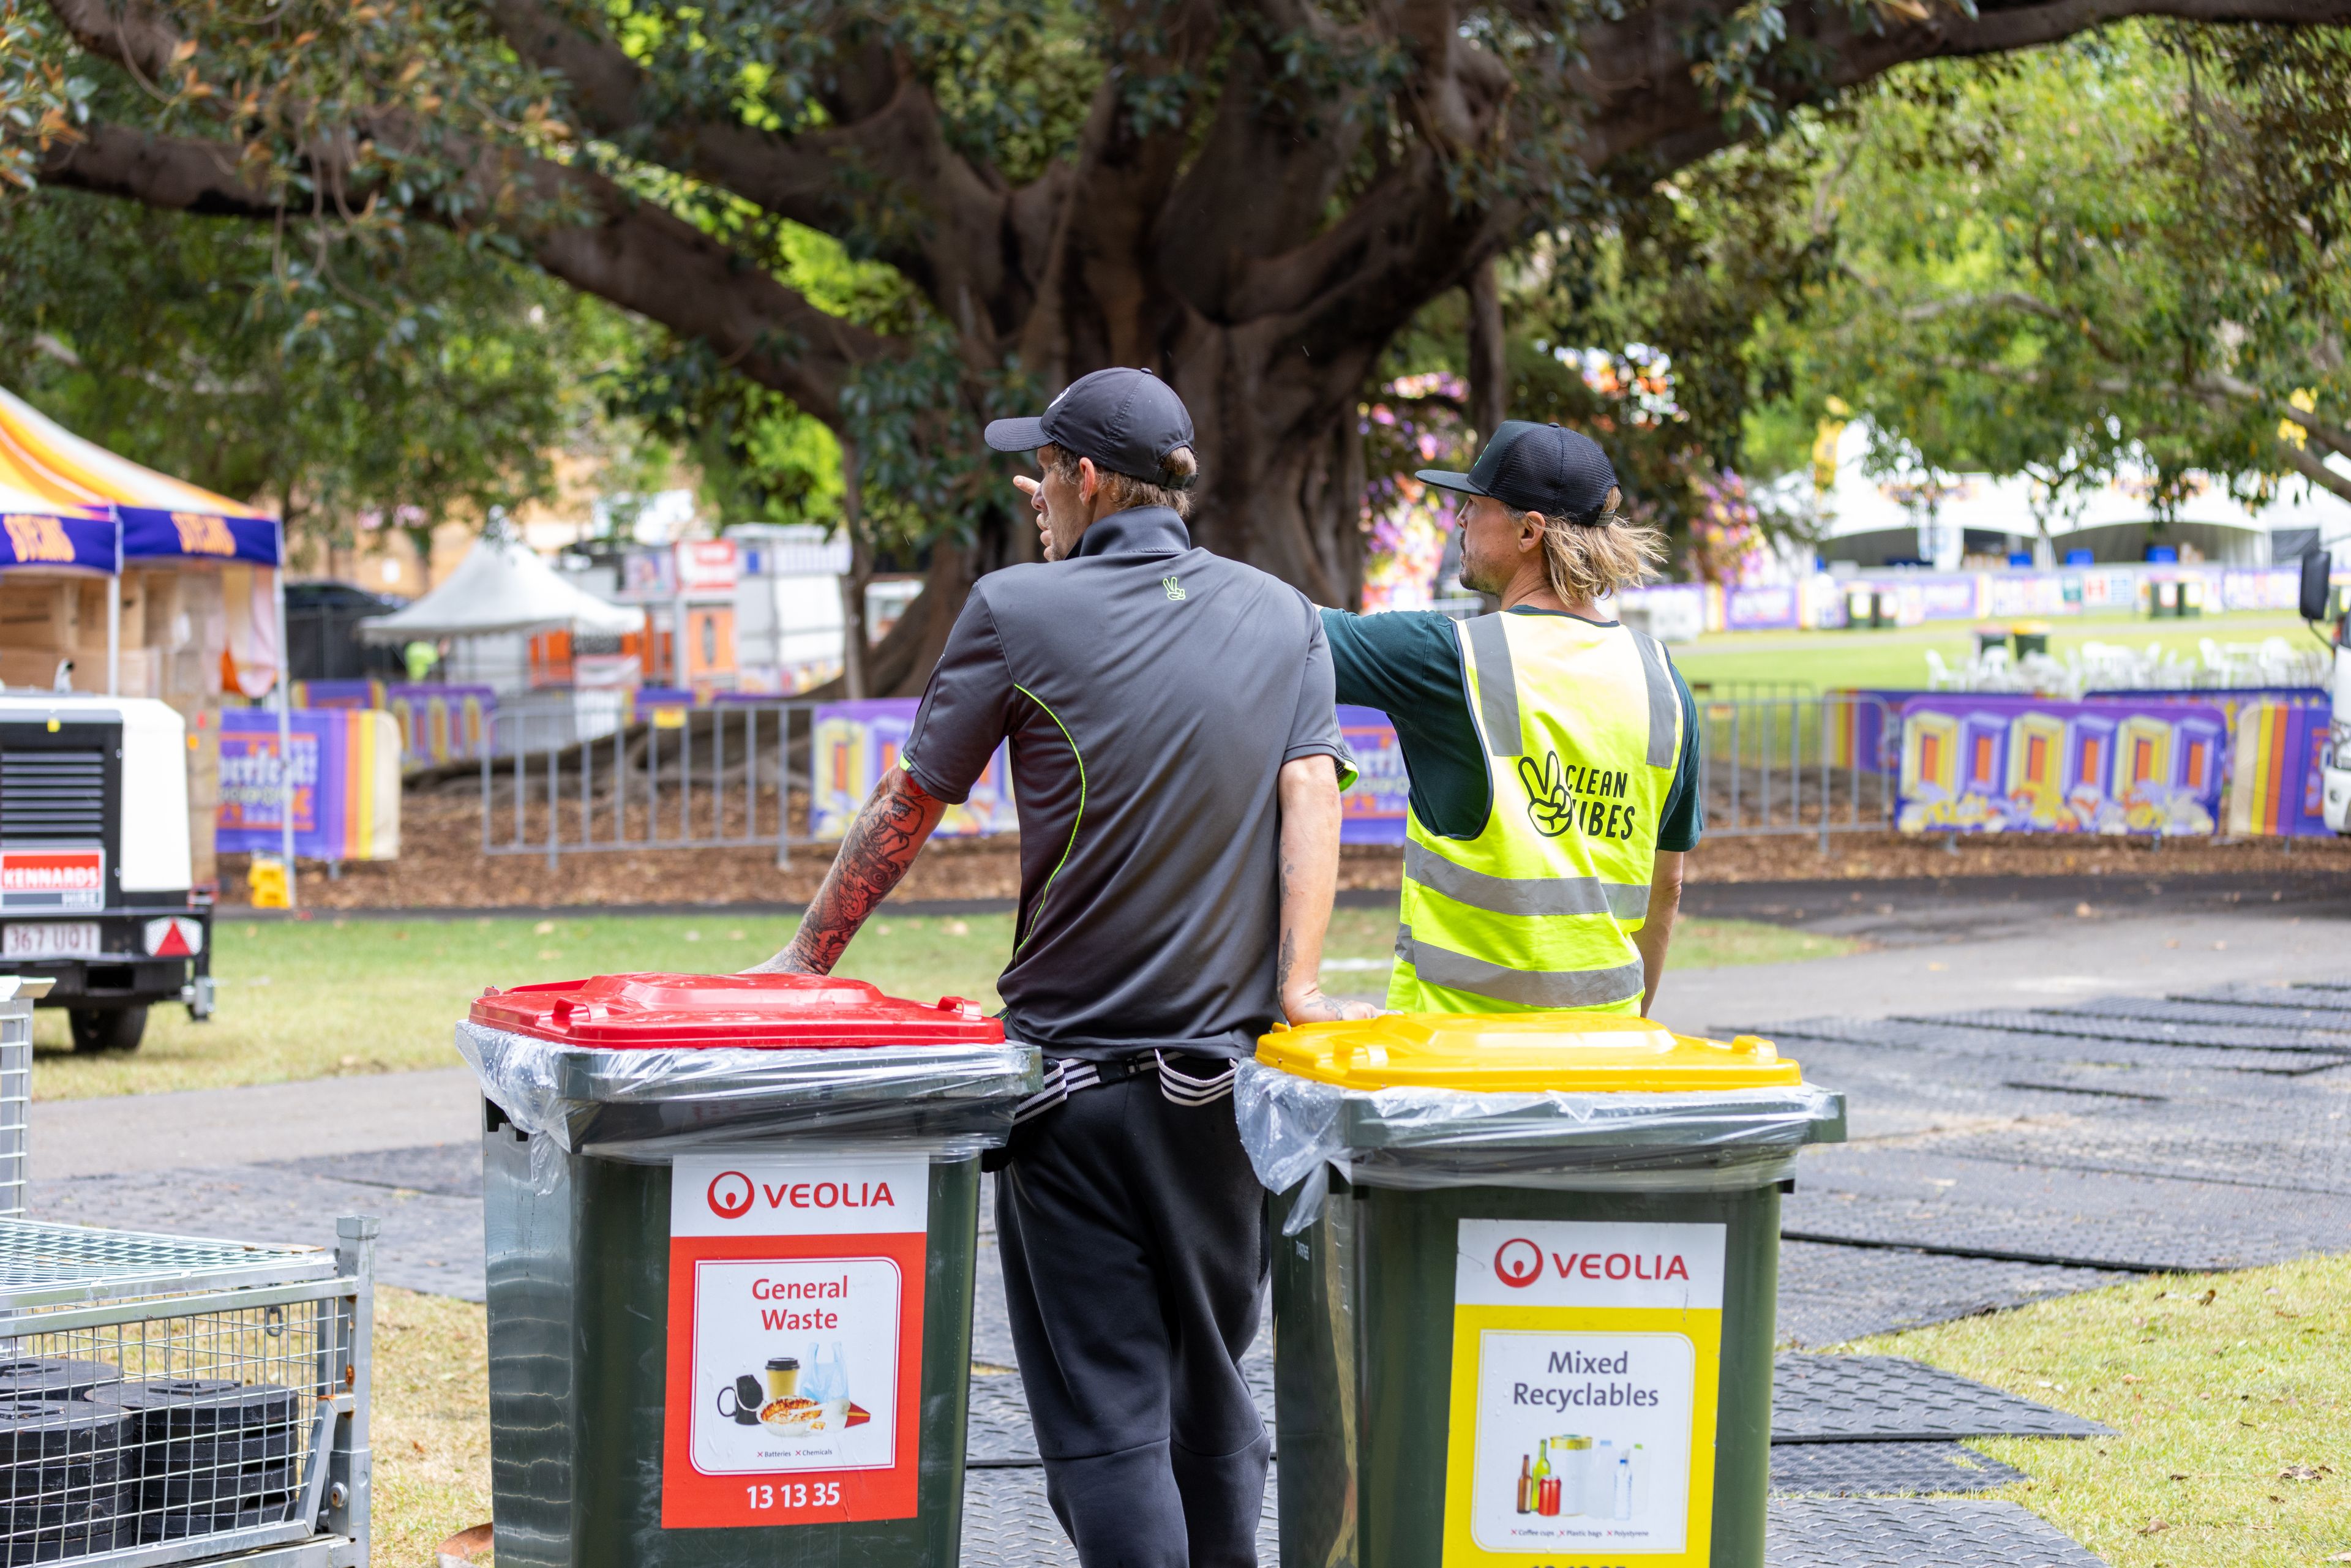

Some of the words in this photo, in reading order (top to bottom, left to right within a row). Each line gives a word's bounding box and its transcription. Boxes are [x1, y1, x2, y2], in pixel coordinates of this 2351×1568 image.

[1565, 765, 1628, 798] CLEAN
[3, 867, 99, 889] KENNARDS
[62, 891, 97, 907] HIRE
[9, 923, 44, 951] 367
[762, 1182, 895, 1209] VEOLIA
[1552, 1253, 1690, 1280] VEOLIA
[751, 1275, 848, 1300] General
[761, 1308, 838, 1330] Waste
[1547, 1350, 1629, 1375] Mixed
[1513, 1382, 1659, 1414] Recyclables
[746, 1485, 774, 1509] 13
[780, 1484, 807, 1508] 13
[812, 1482, 841, 1506] 35
[1588, 1529, 1602, 1539] bags
[1614, 1530, 1649, 1539] Polystyrene
